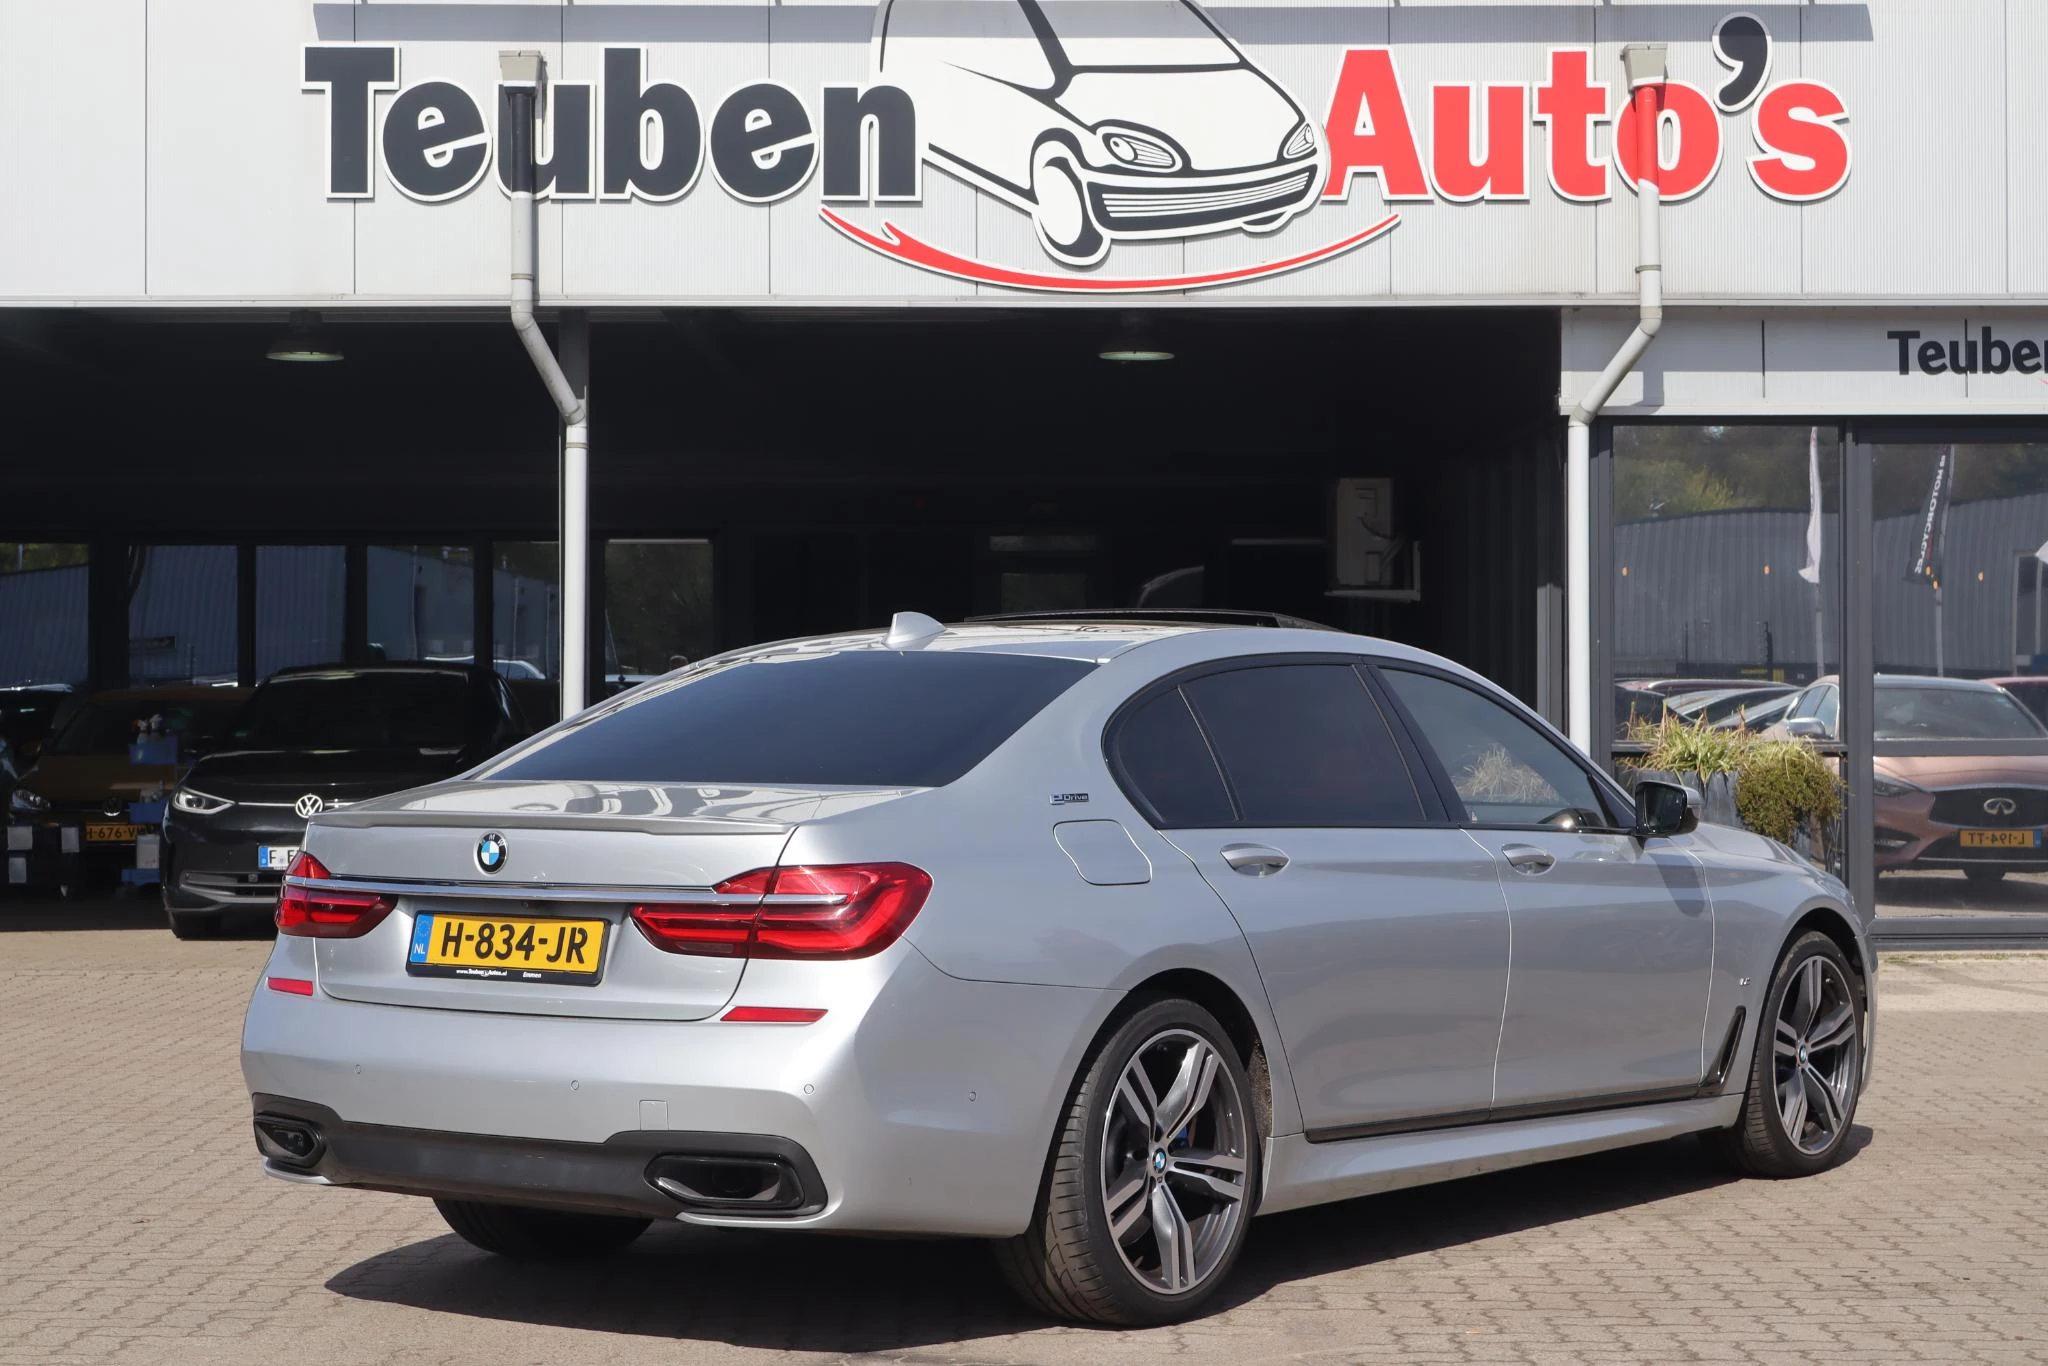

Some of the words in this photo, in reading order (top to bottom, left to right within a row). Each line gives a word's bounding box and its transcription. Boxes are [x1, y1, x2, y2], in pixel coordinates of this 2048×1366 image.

[301, 42, 922, 202] Teuben
[1321, 14, 1852, 202] Auto's
[1887, 326, 2048, 375] Teube
[441, 921, 588, 964] H-834-JR
